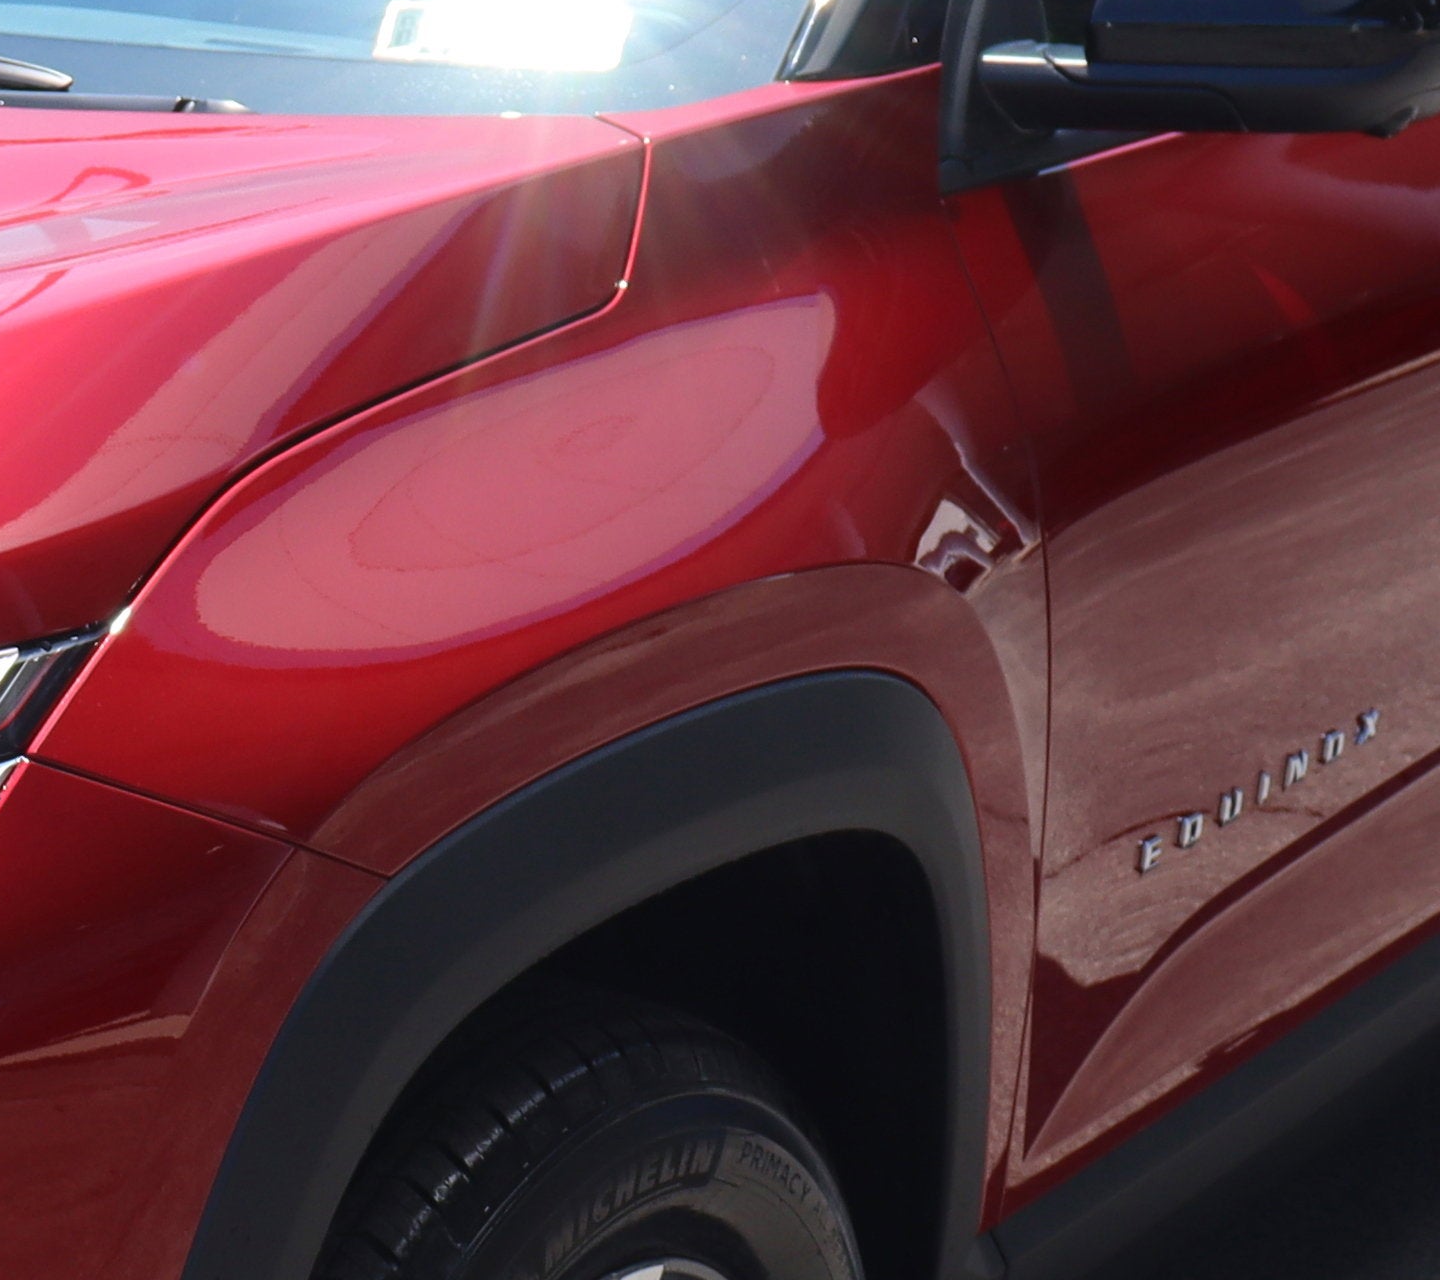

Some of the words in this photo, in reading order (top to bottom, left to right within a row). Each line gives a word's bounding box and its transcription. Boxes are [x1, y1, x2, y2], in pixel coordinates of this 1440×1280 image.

[1134, 707, 1382, 876] EQUINOX
[544, 1137, 715, 1273] MICHELIN
[736, 1140, 812, 1203] PRIMACY
